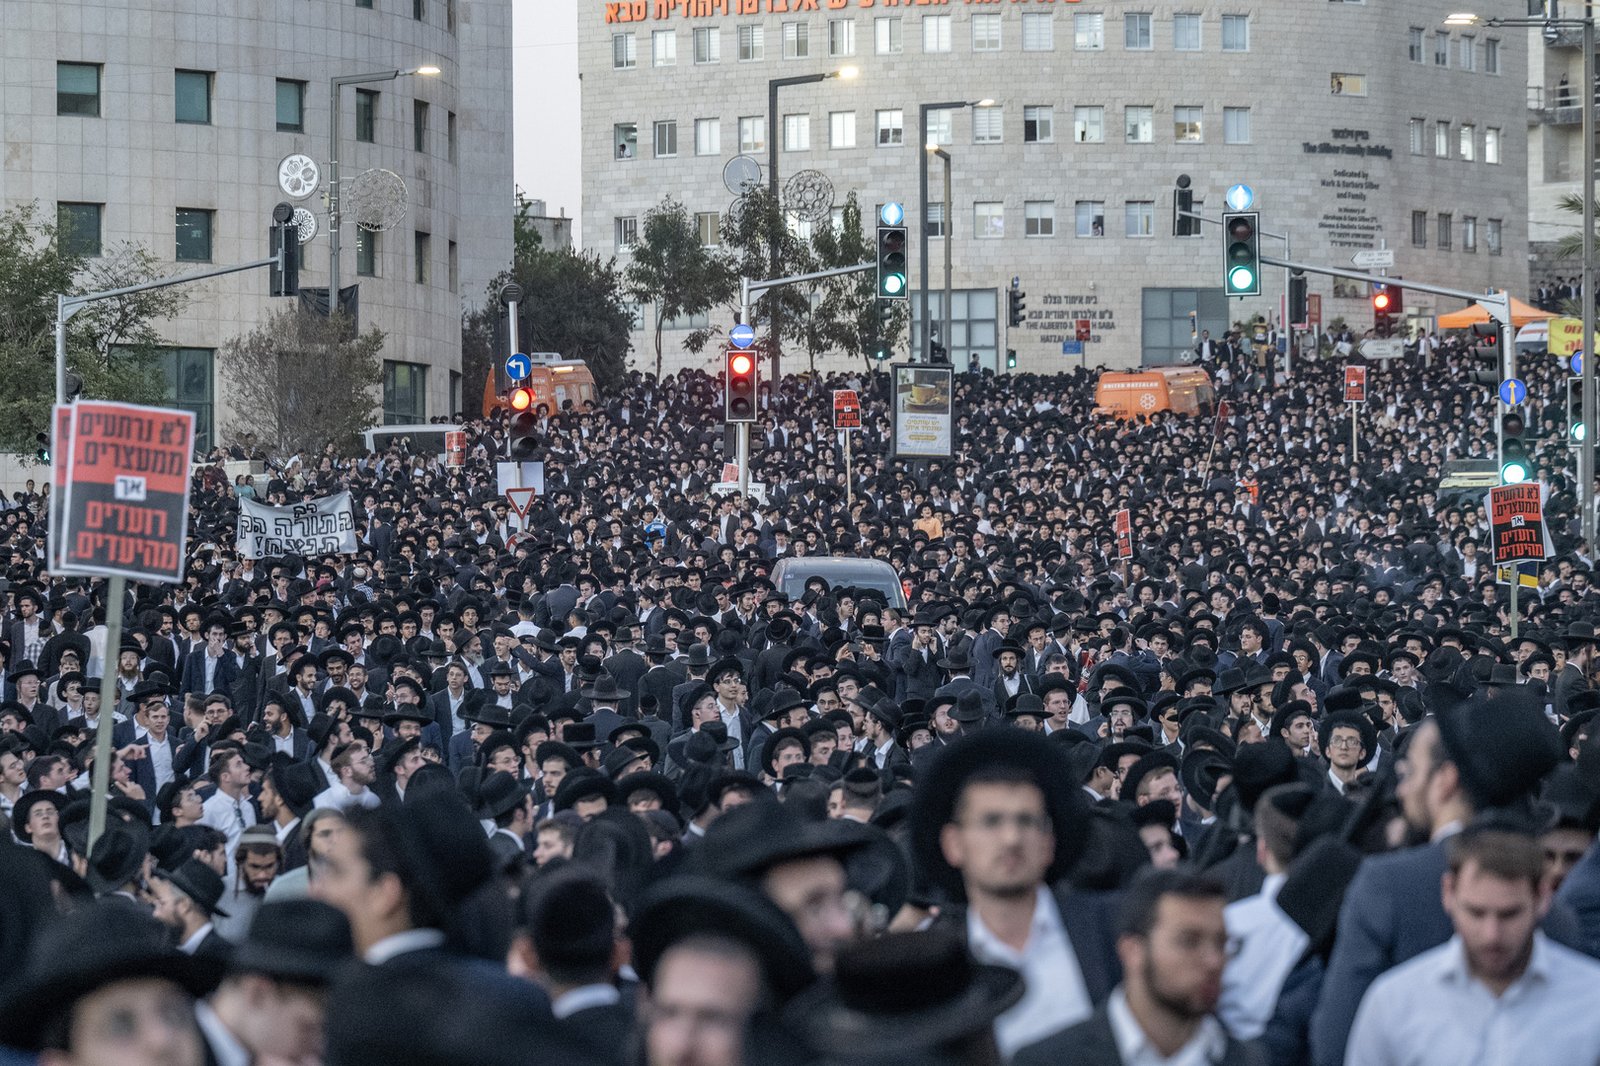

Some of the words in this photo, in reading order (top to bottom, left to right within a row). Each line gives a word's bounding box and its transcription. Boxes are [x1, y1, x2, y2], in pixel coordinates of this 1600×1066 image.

[605, 0, 647, 24] סבא
[1333, 169, 1360, 178] Dedicated
[1320, 179, 1335, 187] Mark
[1342, 180, 1364, 189] Barbara
[1364, 181, 1380, 190] Silber
[1336, 191, 1347, 199] and
[1347, 192, 1366, 201] Family
[1042, 293, 1062, 305] הצלה
[1064, 295, 1084, 305] איחוד
[1085, 295, 1098, 305] בית
[1028, 310, 1043, 319] סבא
[1026, 322, 1038, 330] THE
[1039, 322, 1068, 330] ALBERTO
[79, 412, 153, 443] נרתעים
[159, 418, 188, 447] לא
[77, 441, 184, 477] ממעצרים.
[117, 478, 142, 496] אך
[1493, 487, 1524, 503] נרתעים
[1527, 486, 1539, 499] לא
[293, 503, 317, 518] רק
[1494, 501, 1539, 518] ממעצרים.
[85, 500, 168, 538] רועדים
[274, 511, 354, 538] התורה
[1512, 516, 1523, 525] אך
[1501, 529, 1537, 545] רועדים
[69, 531, 179, 571] מהיעדים.
[255, 536, 340, 557] תנצח!
[1496, 543, 1544, 560] מהיעדים.
